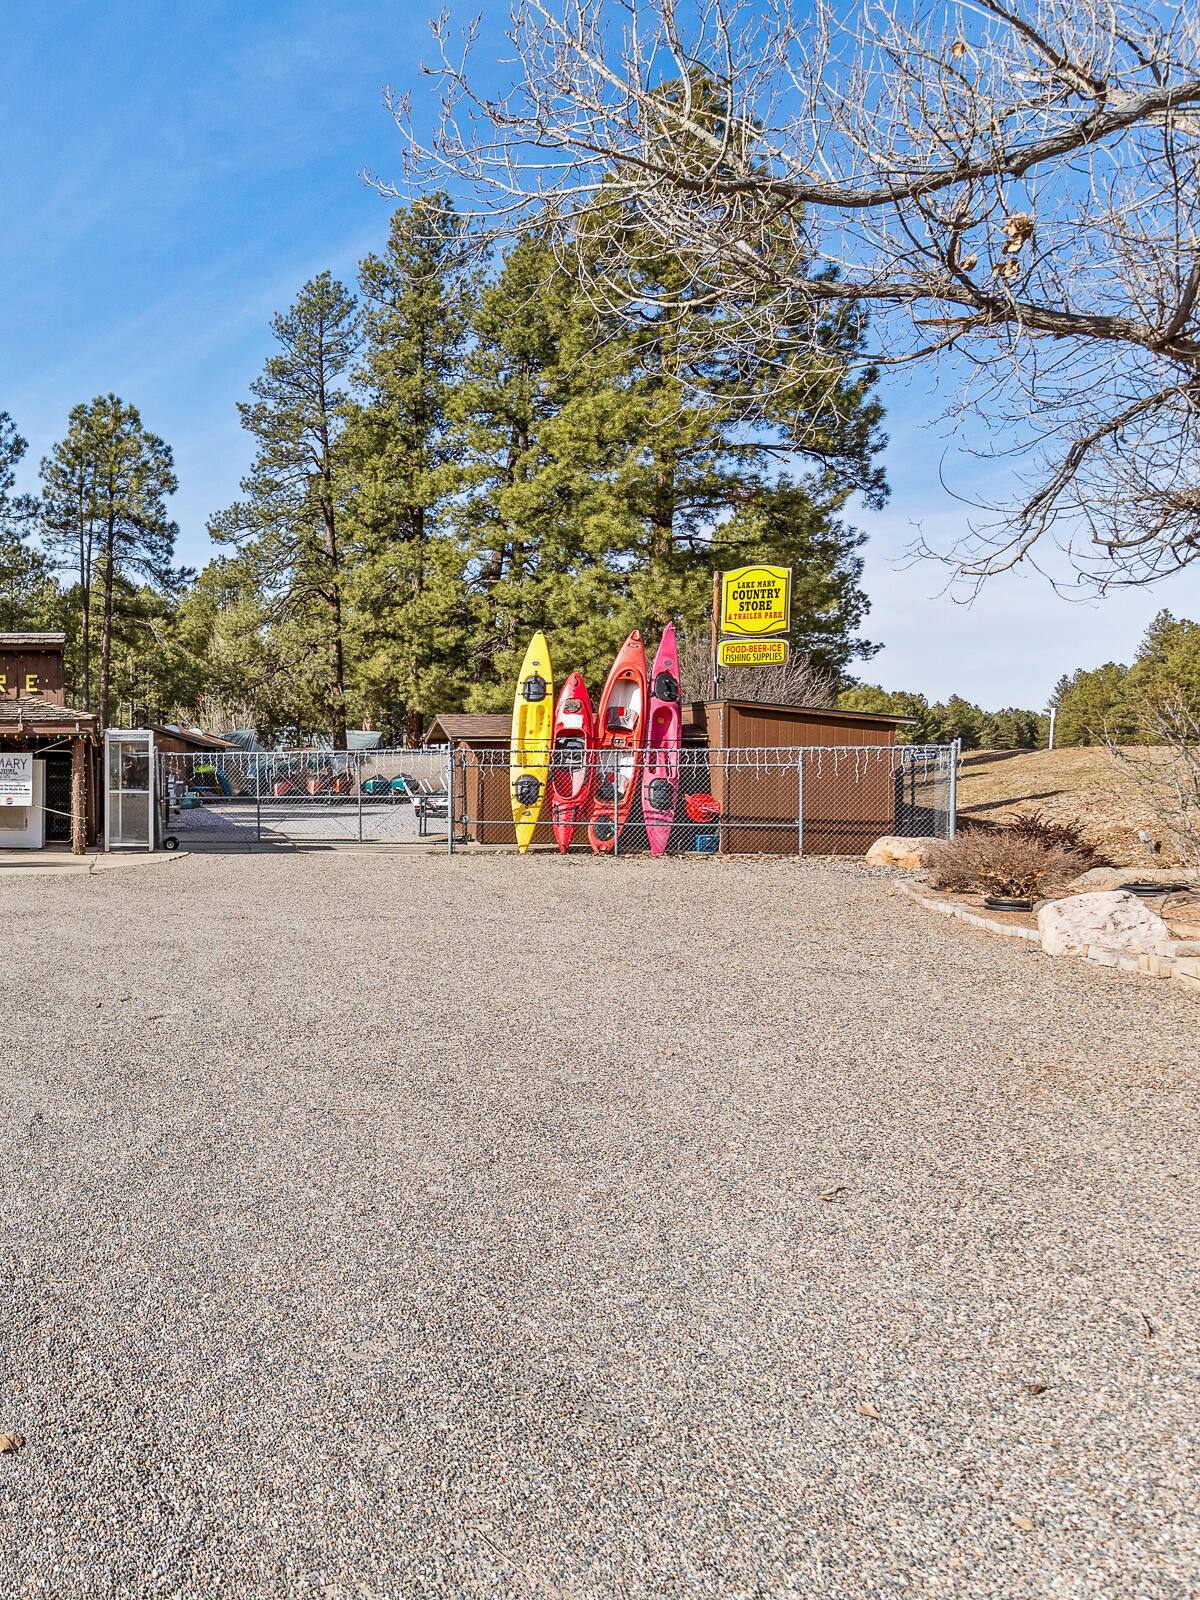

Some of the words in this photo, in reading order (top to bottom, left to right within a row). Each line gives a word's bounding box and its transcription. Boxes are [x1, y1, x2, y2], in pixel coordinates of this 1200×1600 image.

[732, 588, 780, 600] COUNTRY
[739, 600, 772, 611] STORE
[725, 653, 751, 662] FISHING
[753, 652, 782, 661] SUPPLIES
